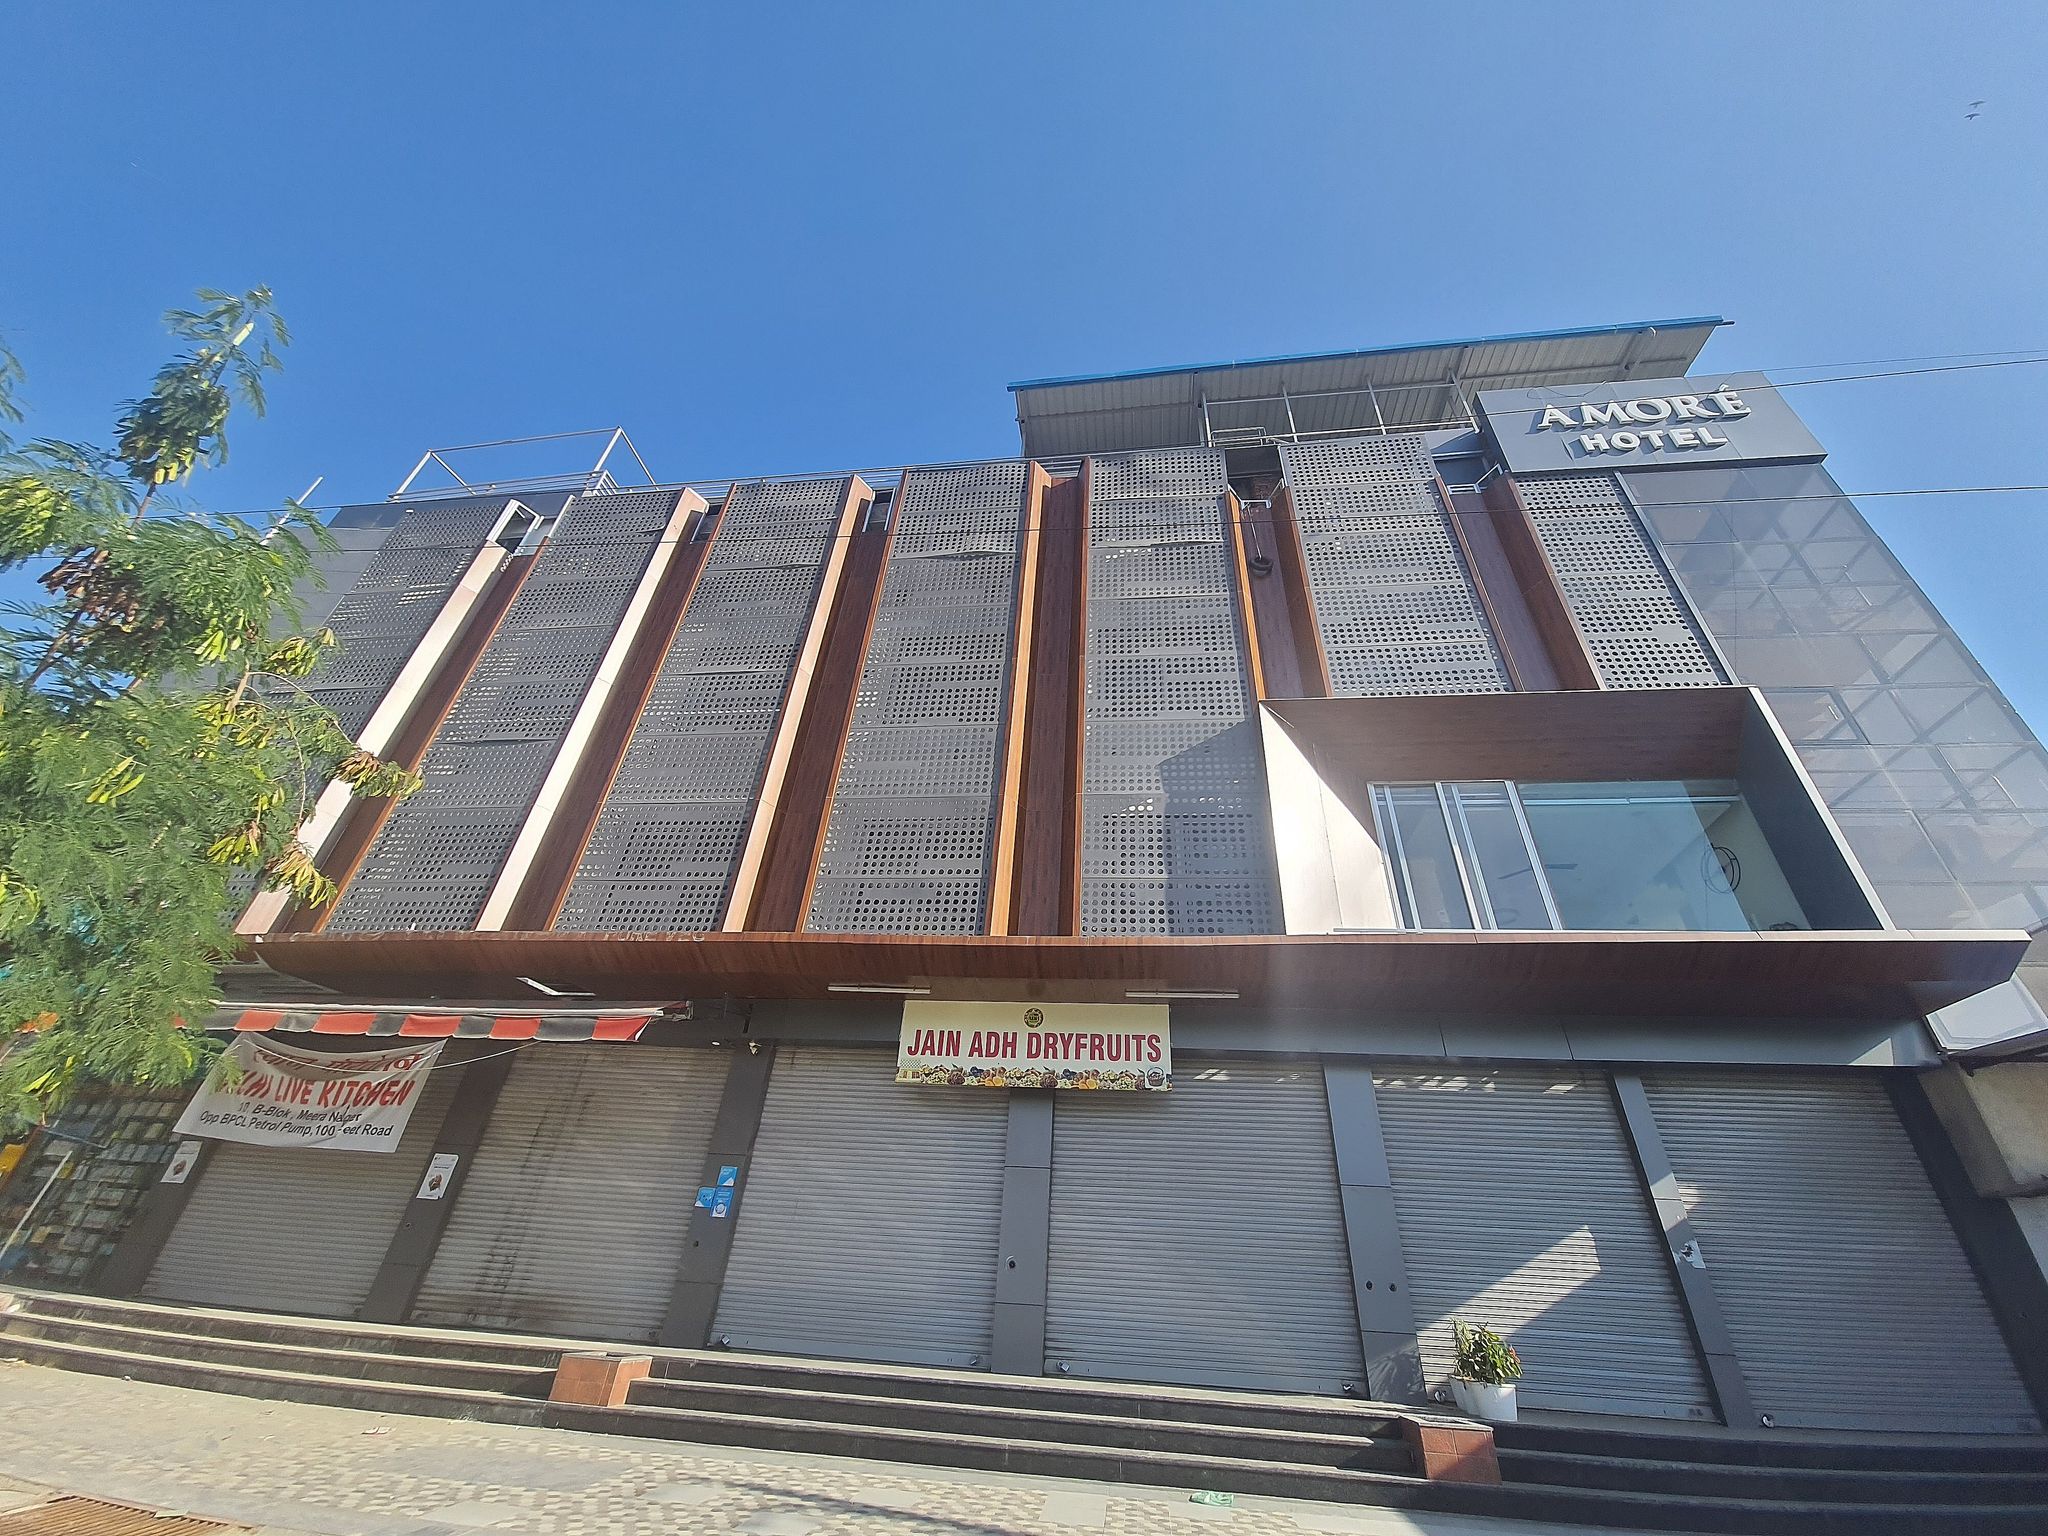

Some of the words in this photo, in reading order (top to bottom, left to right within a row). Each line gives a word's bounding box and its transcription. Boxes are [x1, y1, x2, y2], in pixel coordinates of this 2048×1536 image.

[1537, 384, 1752, 428] AMORÉ
[1580, 427, 1728, 453] HOTEL
[907, 1029, 961, 1057] JAIN
[968, 1031, 1017, 1059] ADH
[1026, 1032, 1162, 1063] DRYFRUITS
[275, 1076, 315, 1105] LIVE
[317, 1080, 416, 1108] KITCHEN
[200, 1110, 219, 1125] Opp
[220, 1113, 247, 1127] BPCL
[247, 1117, 281, 1132] Petrol
[337, 1123, 361, 1135] eet
[361, 1123, 394, 1136] Road
[296, 1109, 327, 1121] Meera
